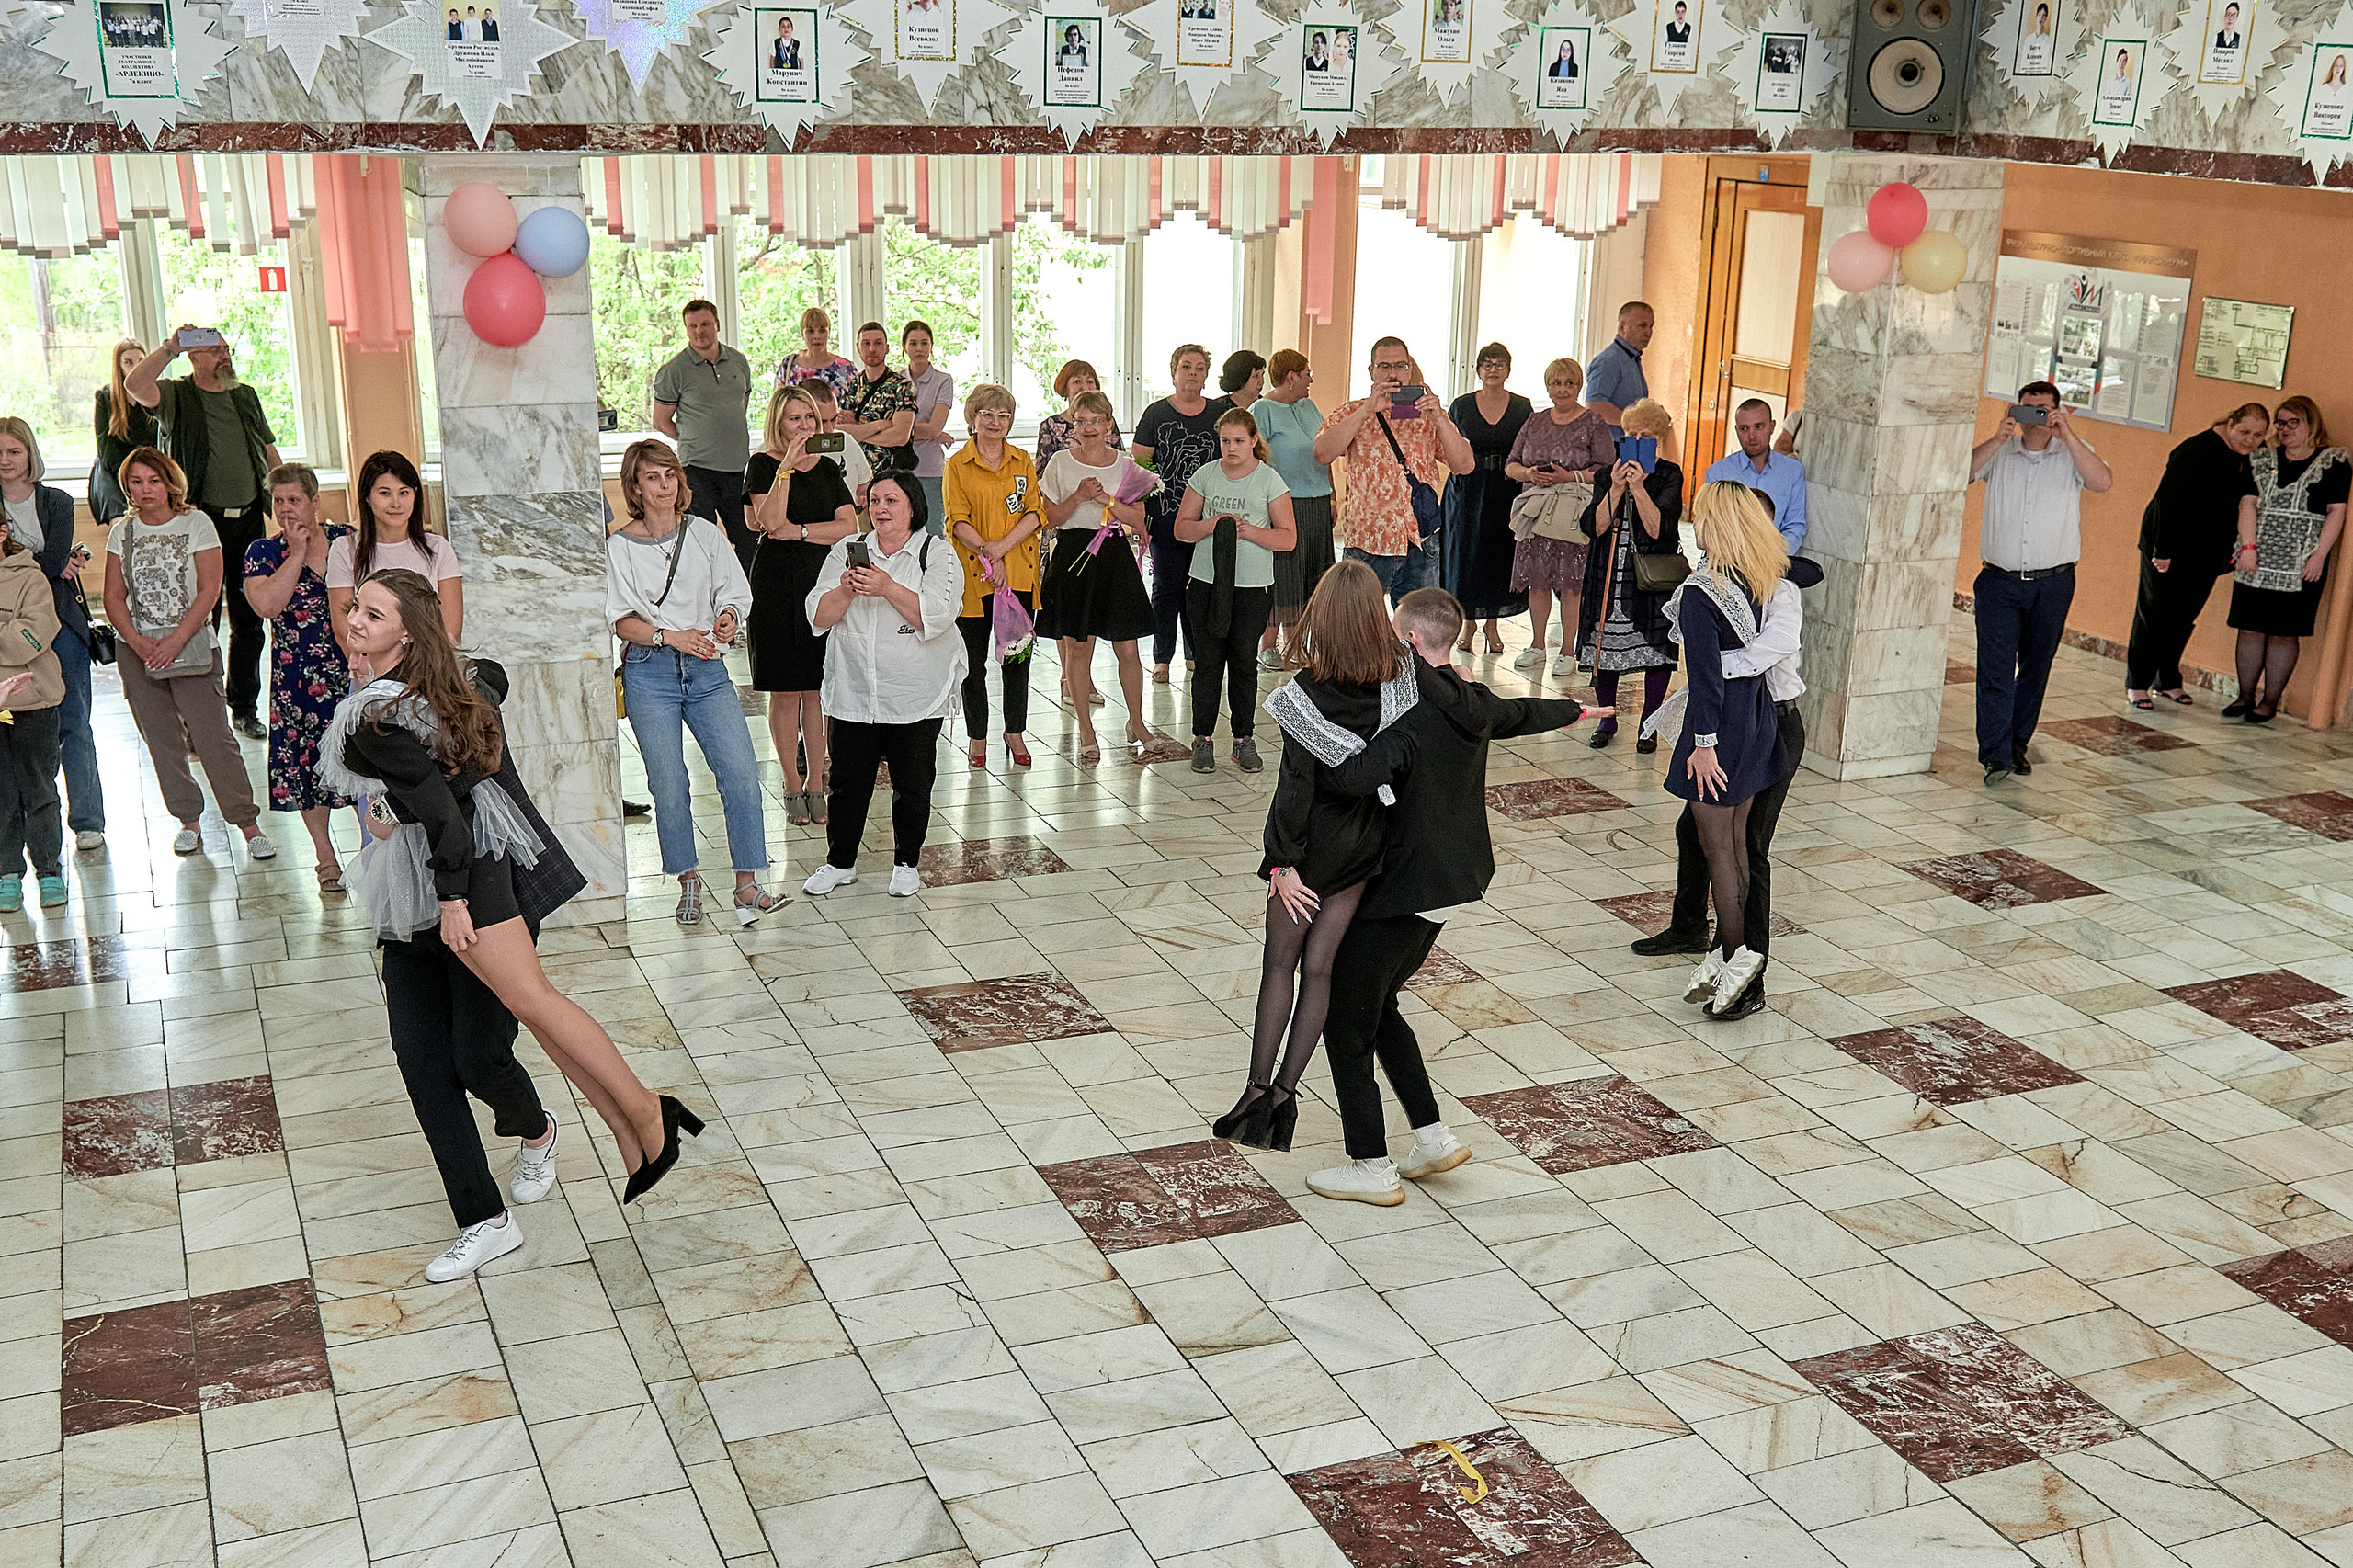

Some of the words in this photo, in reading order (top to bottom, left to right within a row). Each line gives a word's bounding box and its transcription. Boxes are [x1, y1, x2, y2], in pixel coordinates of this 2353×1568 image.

[908, 26, 939, 34] Кузнецов
[772, 69, 802, 77] Марунич
[1211, 495, 1245, 510] GREEN
